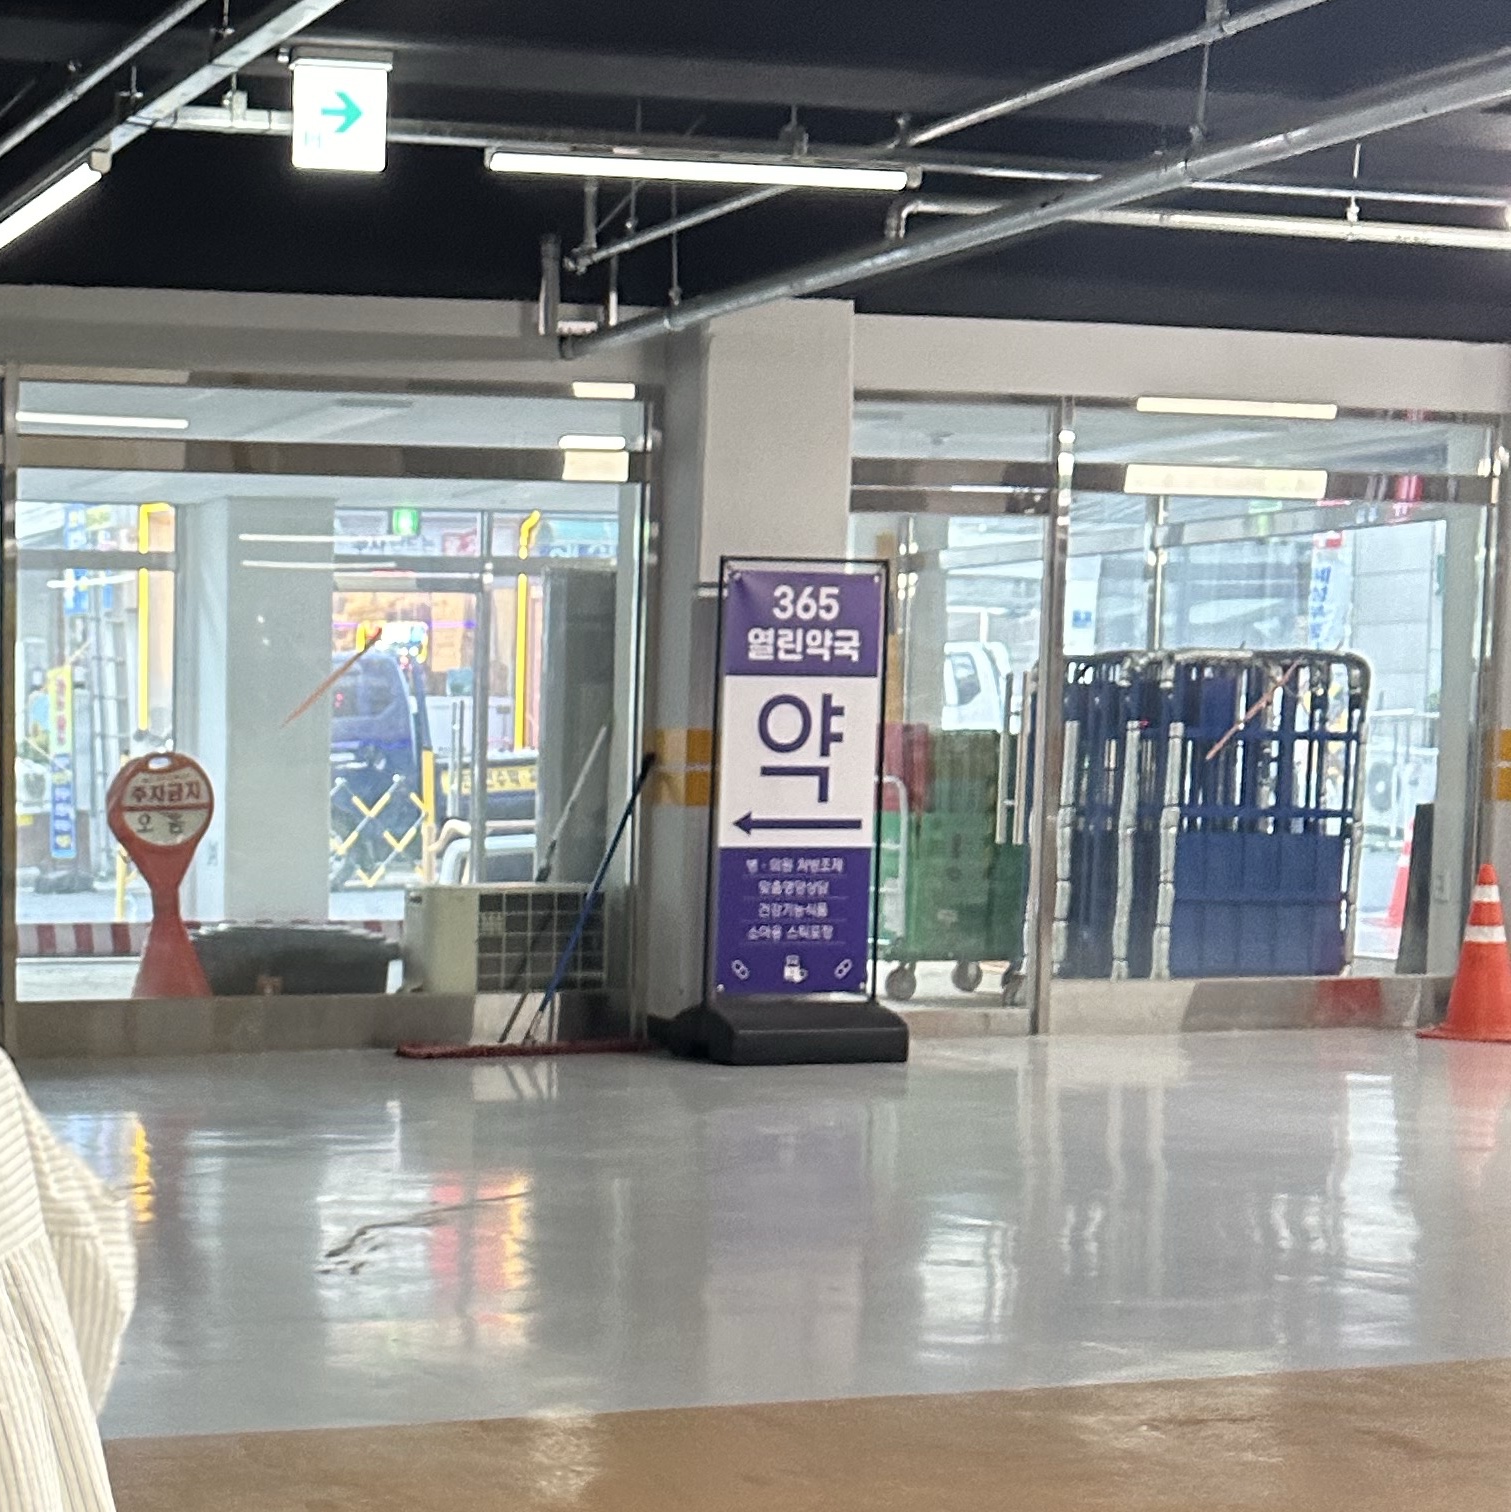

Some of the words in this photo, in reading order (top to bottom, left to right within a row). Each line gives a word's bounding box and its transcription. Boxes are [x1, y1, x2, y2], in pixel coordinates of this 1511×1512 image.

[772, 584, 839, 620] 365
[747, 627, 861, 662] 열린약국
[758, 693, 845, 803] 약
